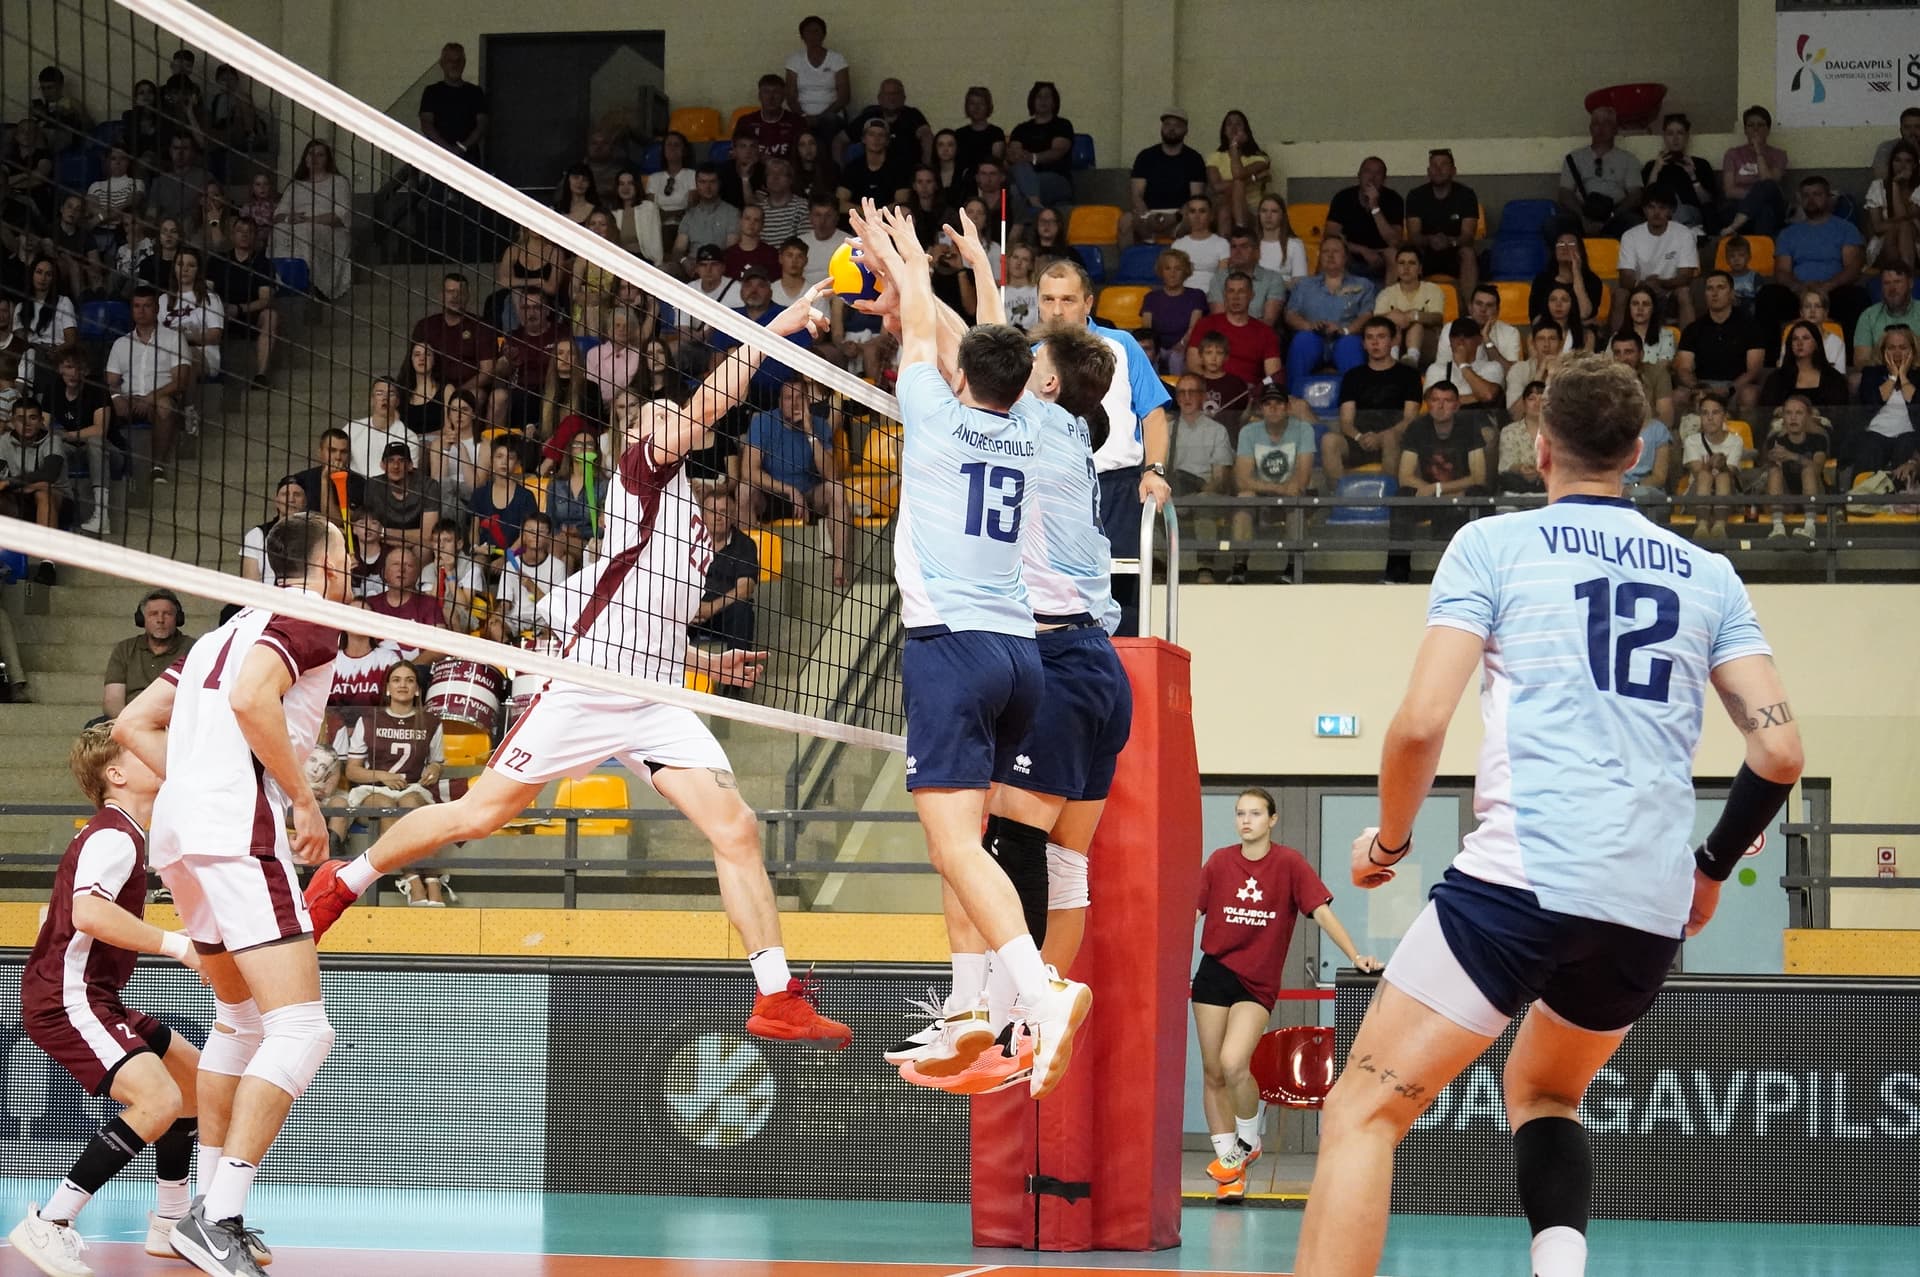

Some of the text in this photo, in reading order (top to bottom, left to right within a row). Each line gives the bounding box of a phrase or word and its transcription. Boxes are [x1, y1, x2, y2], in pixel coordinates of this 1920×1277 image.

[1825, 59, 1893, 70] DAUGAVPILS
[952, 423, 1036, 457] ANDREOPOULOS
[960, 461, 1025, 543] 13
[1539, 525, 1692, 578] VOULKIDIS
[1574, 577, 1680, 703] 12
[376, 727, 427, 741] KRONBERGS
[504, 747, 532, 773] 22
[1225, 915, 1267, 926] LATVIJA
[115, 1023, 137, 1040] 2
